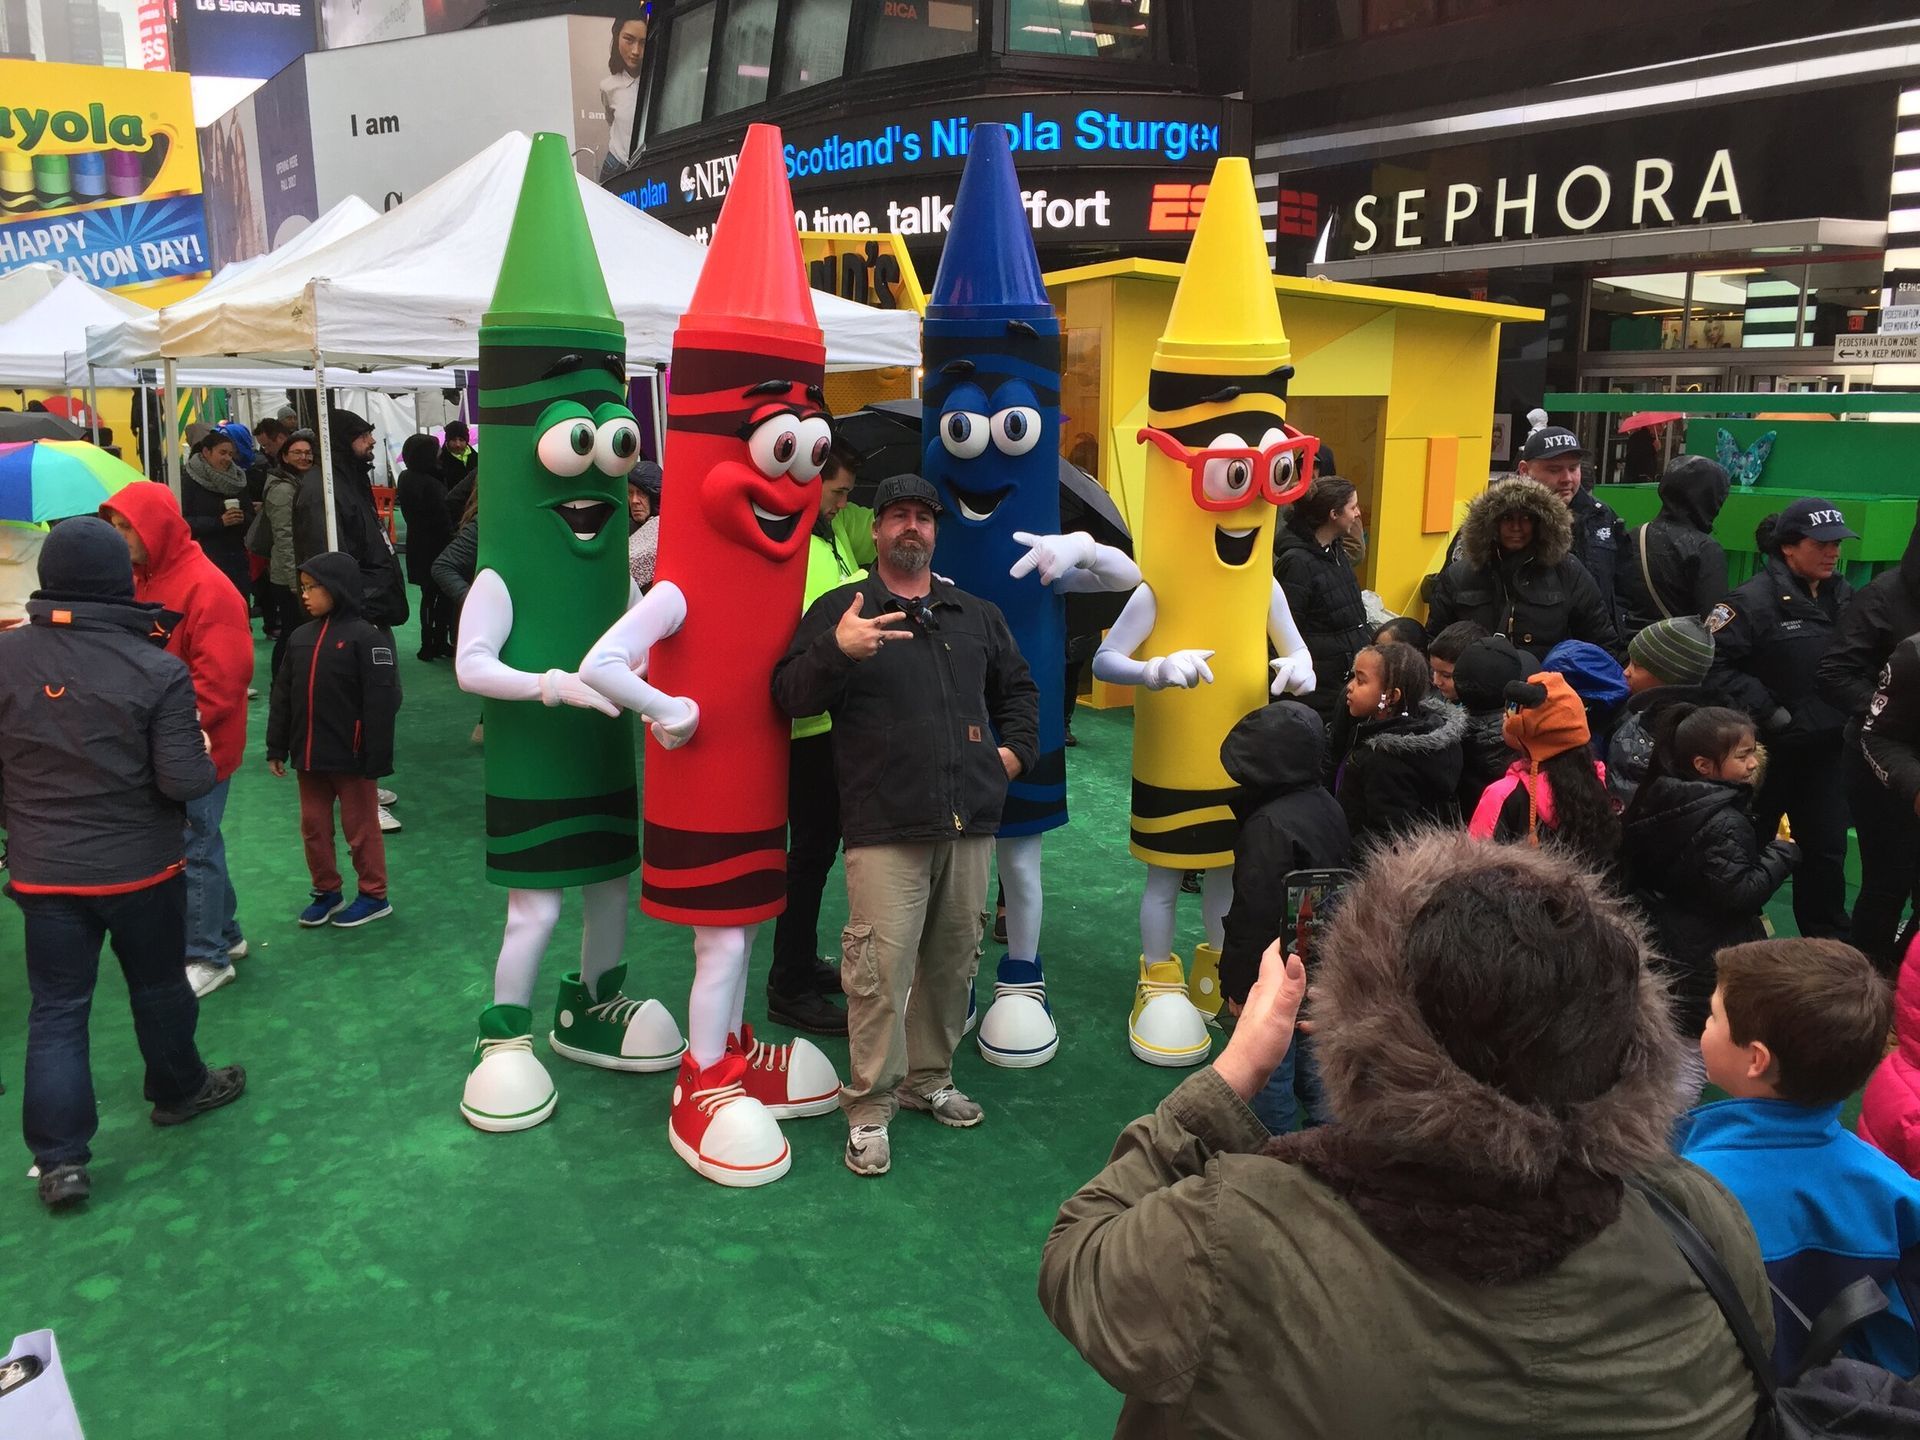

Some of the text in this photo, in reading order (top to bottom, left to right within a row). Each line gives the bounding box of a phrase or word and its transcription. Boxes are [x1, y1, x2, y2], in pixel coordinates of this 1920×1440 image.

[196, 0, 301, 16] LG SIGNATURE
[351, 114, 400, 137] I am
[588, 111, 606, 120] am
[783, 126, 922, 179] Scotland's
[931, 111, 1062, 158] Niola
[640, 178, 668, 210] plan
[1353, 149, 1744, 252] SEPHORA
[0, 219, 86, 263] HAPPY
[141, 234, 204, 271] DAY!
[1838, 337, 1918, 347] PEDESTRIAN FLOW ZONE
[1872, 349, 1917, 358] KEEP MOVING
[1543, 434, 1577, 449] NYPD
